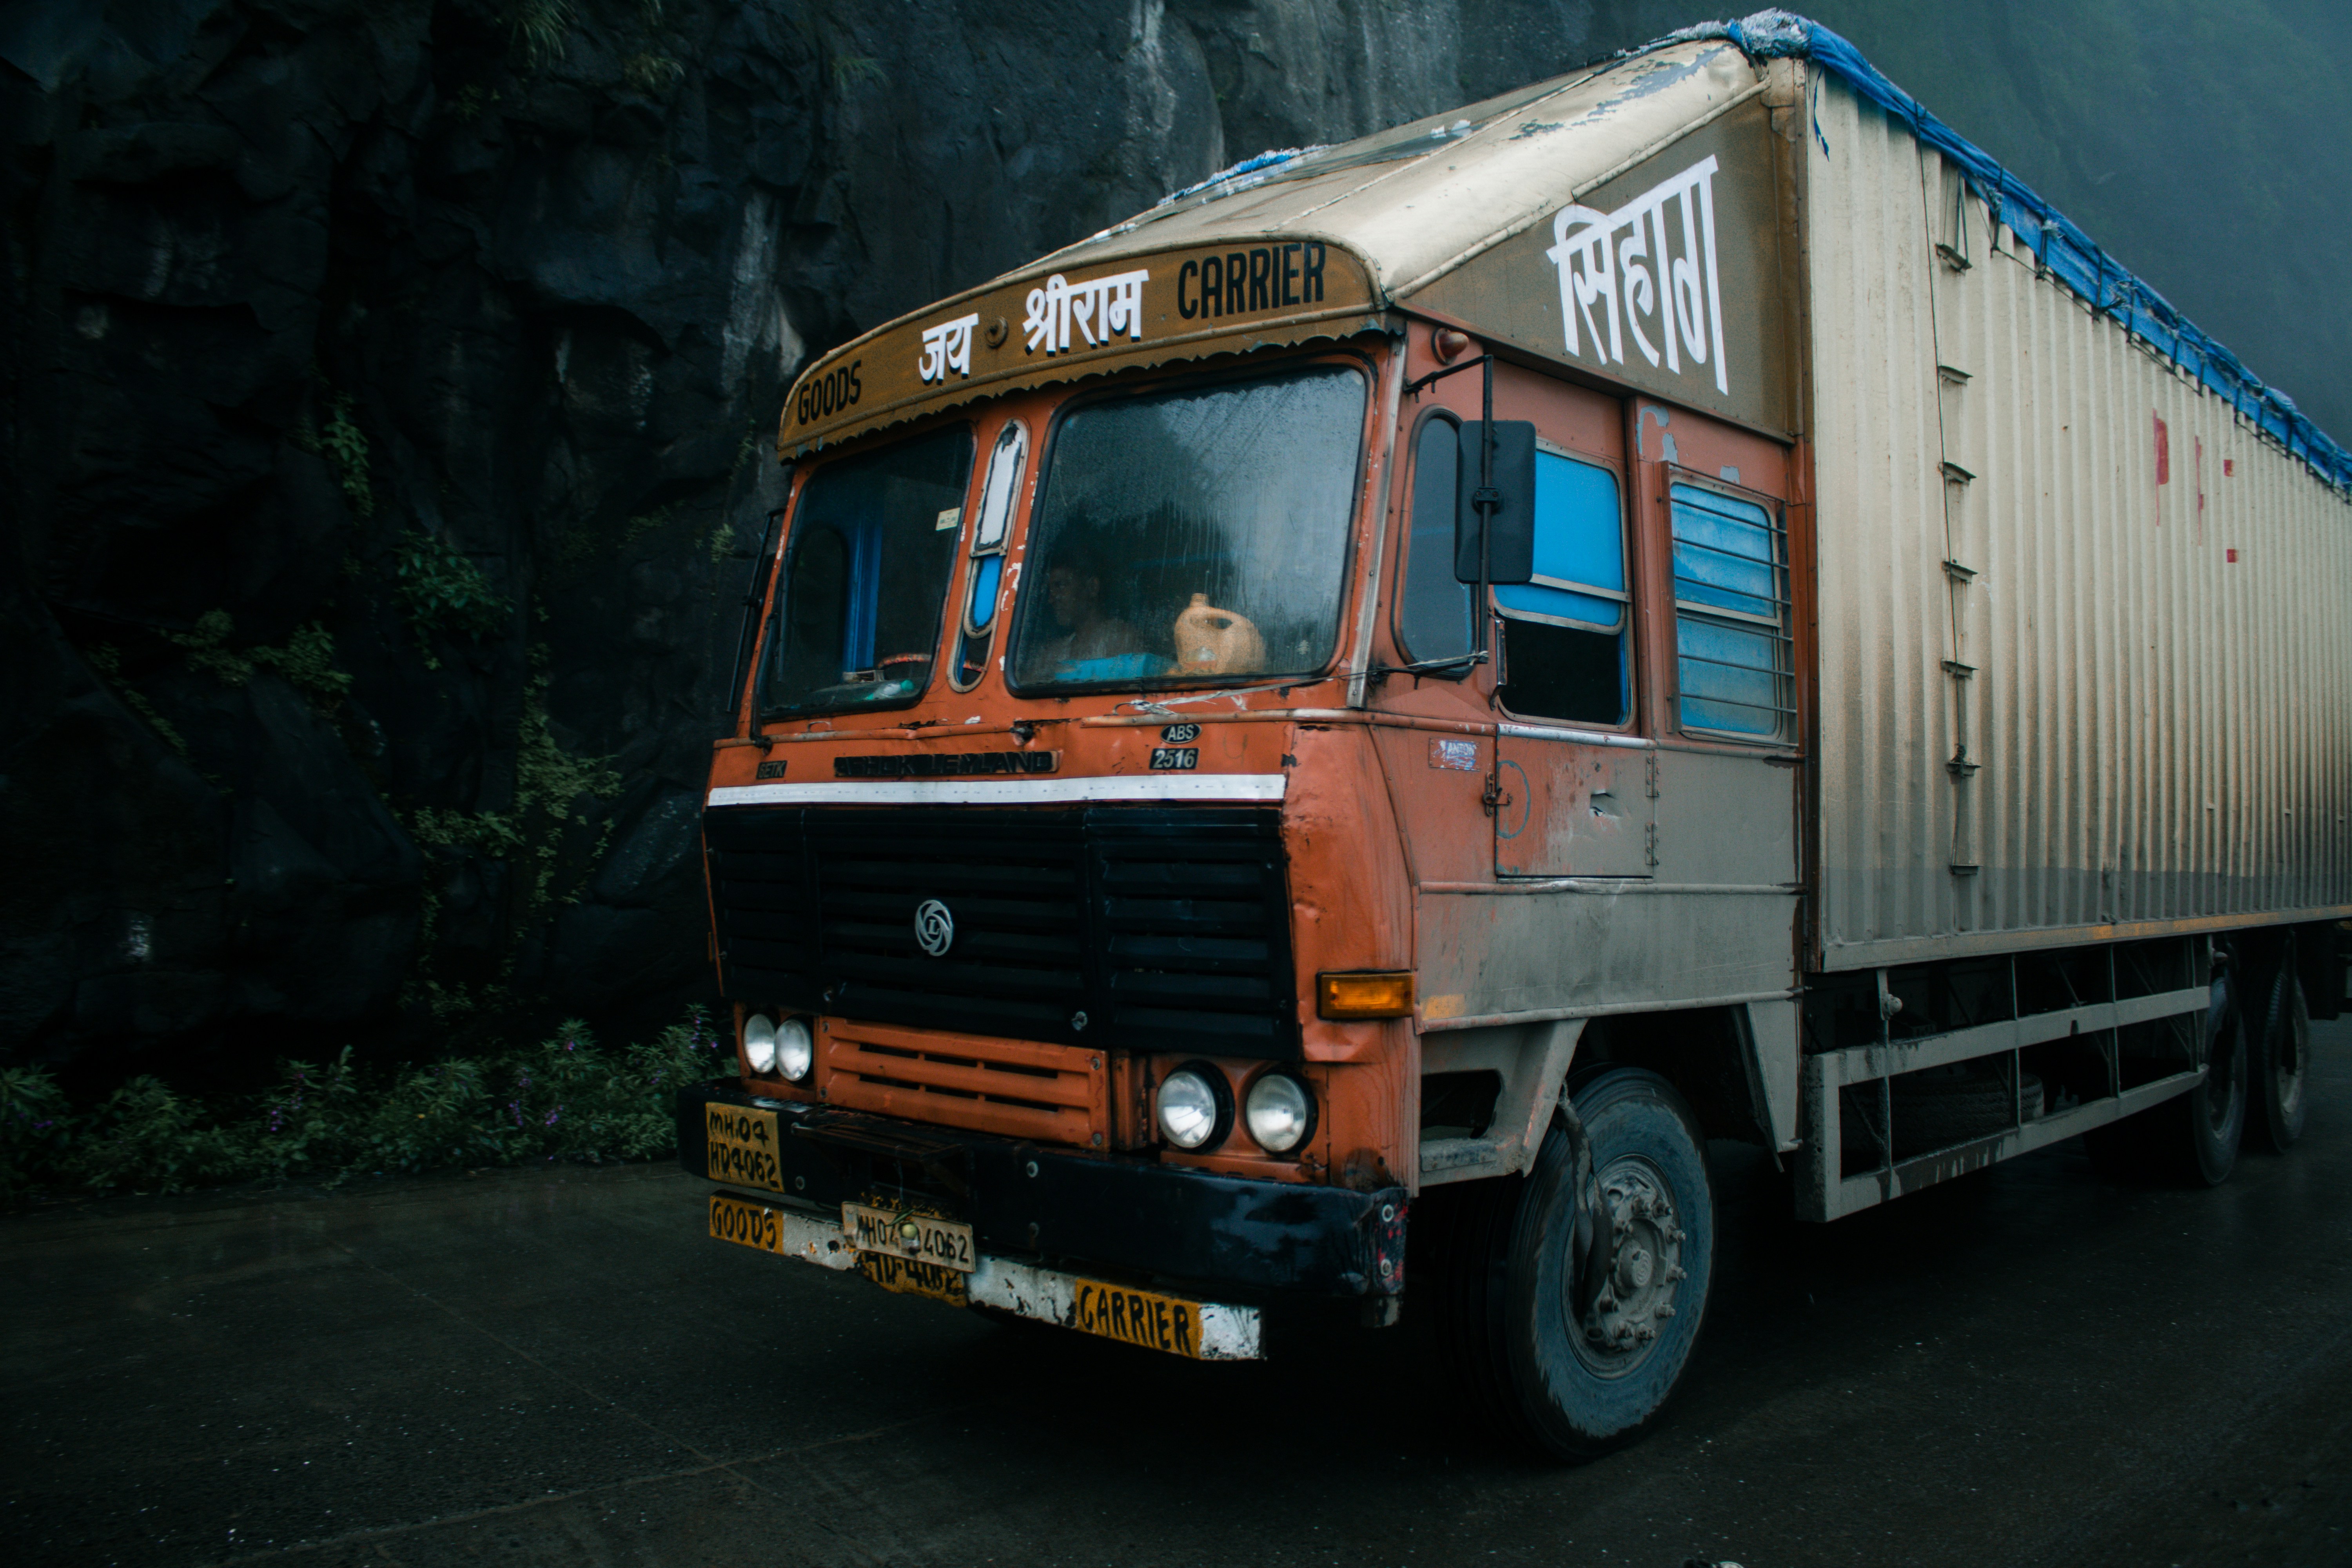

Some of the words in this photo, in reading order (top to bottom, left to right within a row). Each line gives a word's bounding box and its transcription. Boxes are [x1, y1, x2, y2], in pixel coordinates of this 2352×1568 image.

[1178, 240, 1326, 319] CARRIER
[919, 313, 979, 384] जय
[1022, 269, 1149, 356] श्रीराम
[798, 359, 861, 425] GOODS
[1166, 724, 1194, 741] ABS
[925, 751, 1052, 774] LEYLAND
[1152, 750, 1196, 768] 2516
[711, 1142, 780, 1187] HD4062
[712, 1200, 777, 1250] GOODS
[1080, 1285, 1192, 1356] CARRIER
